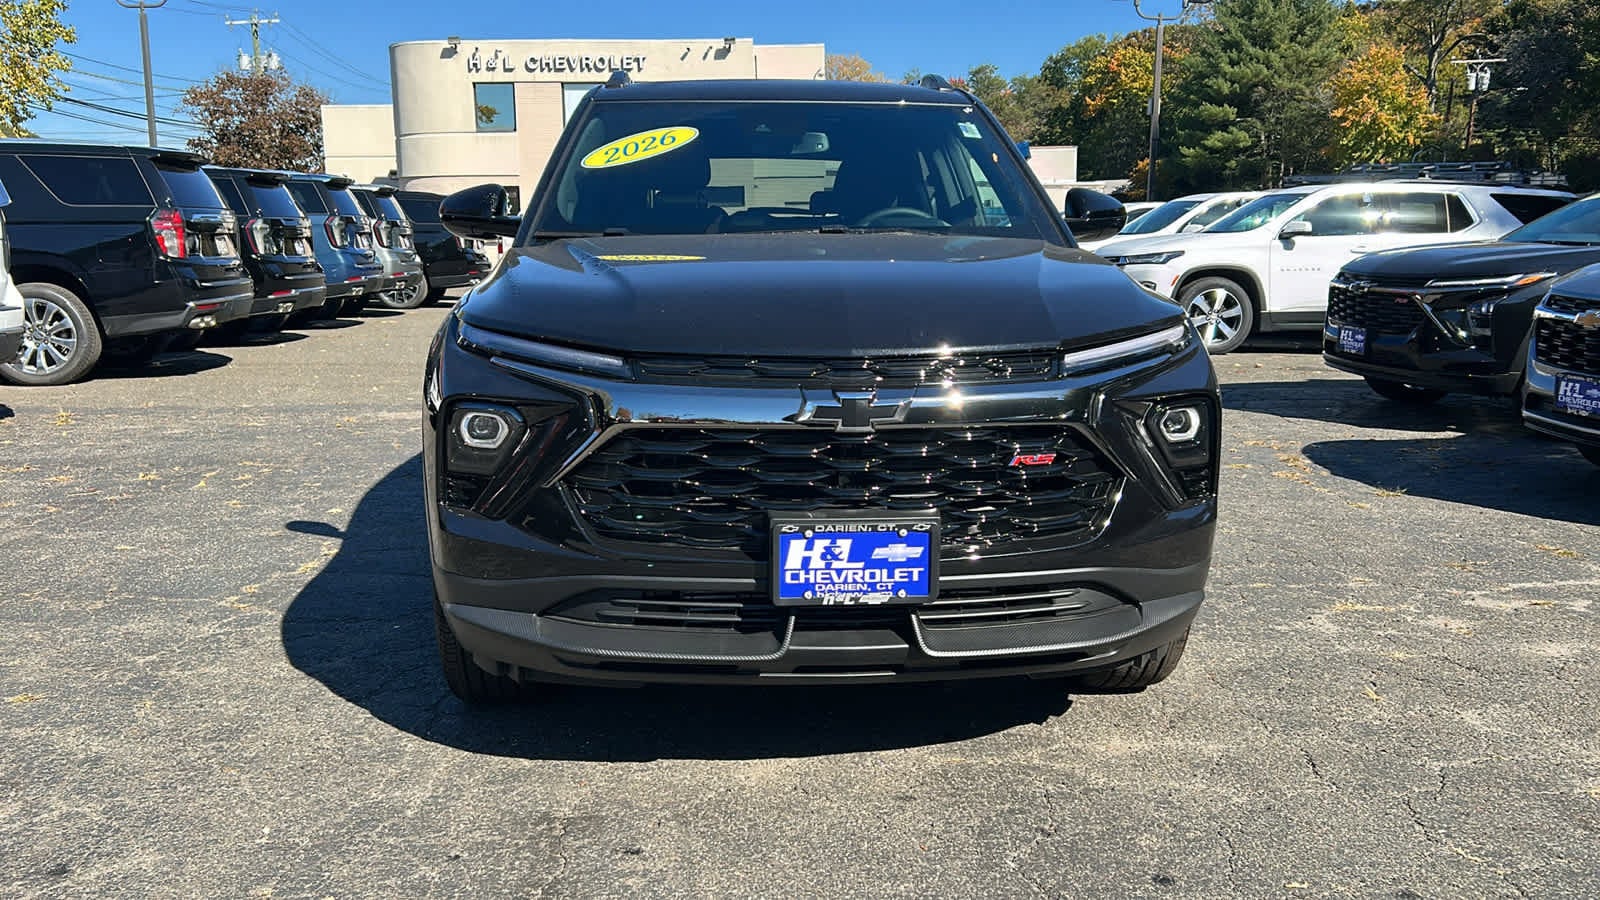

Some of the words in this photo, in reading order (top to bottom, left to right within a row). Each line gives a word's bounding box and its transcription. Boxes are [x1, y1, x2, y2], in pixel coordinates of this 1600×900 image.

[468, 55, 481, 73] H
[486, 56, 500, 71] &
[503, 55, 516, 73] L
[525, 55, 646, 73] CHEVROLET
[604, 130, 677, 164] 2026
[1008, 453, 1056, 466] RS
[815, 524, 872, 533] DARIEN,
[784, 539, 865, 569] H&L
[785, 567, 925, 584] CHEVROLET
[815, 583, 871, 592] DARIEN,
[876, 582, 895, 591] CT
